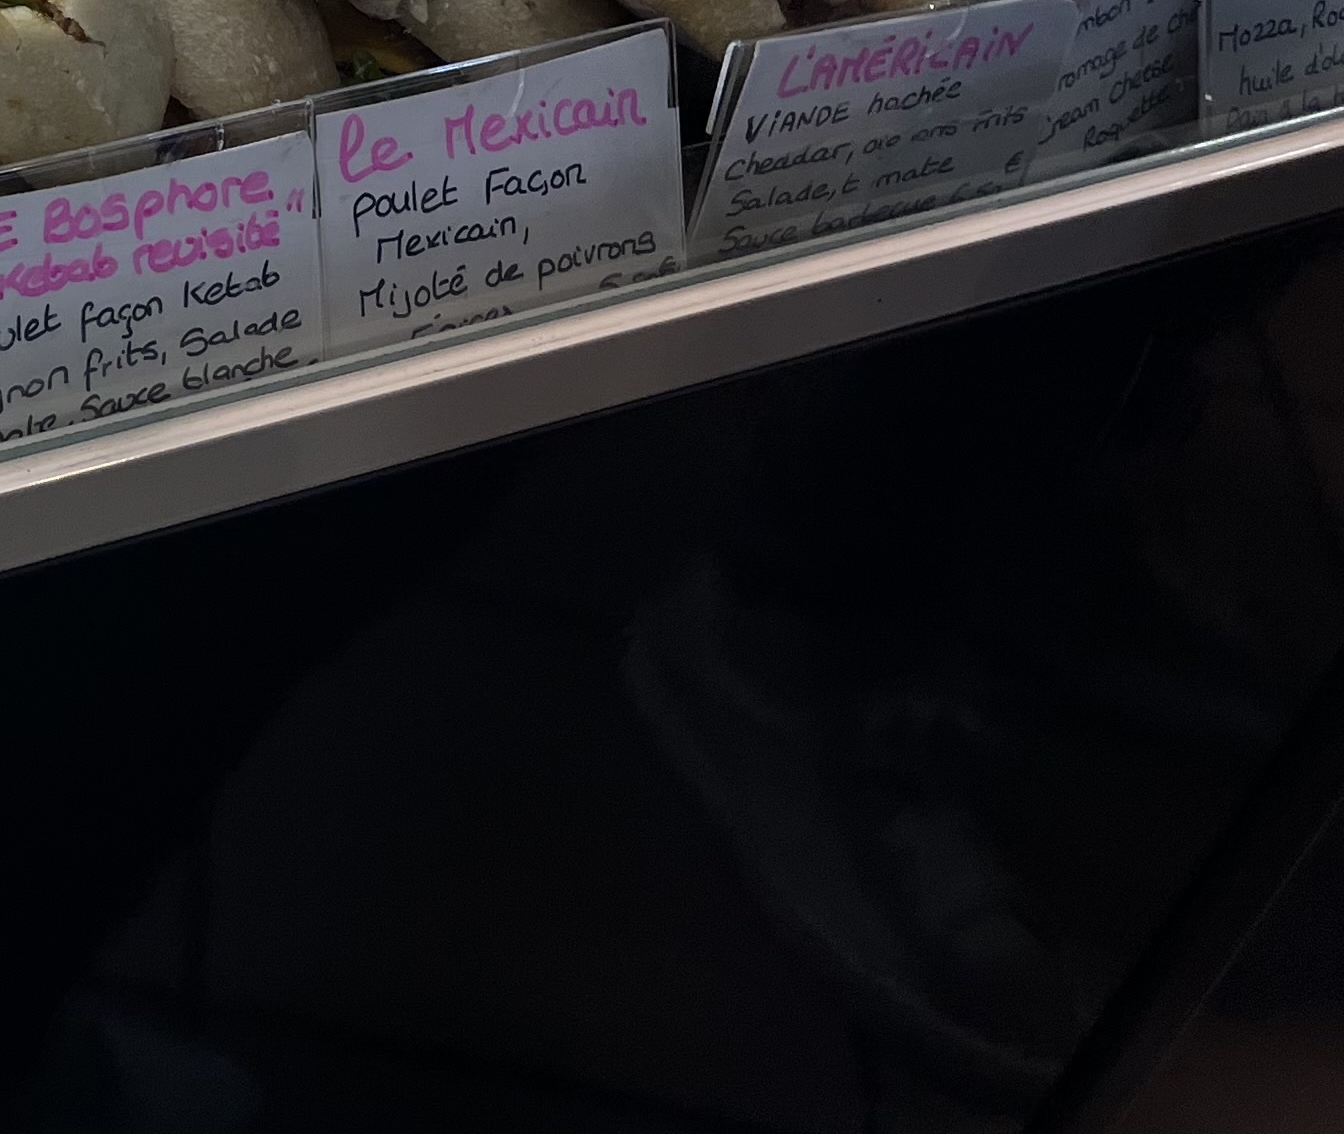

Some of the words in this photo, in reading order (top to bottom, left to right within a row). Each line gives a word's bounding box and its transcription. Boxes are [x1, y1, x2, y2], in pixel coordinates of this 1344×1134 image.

[1057, 39, 1128, 92] romage
[1239, 58, 1295, 96] huile
[444, 87, 647, 159] Mexicain
[485, 260, 524, 288] de
[537, 231, 657, 291] poivrons
[80, 297, 163, 343] façon
